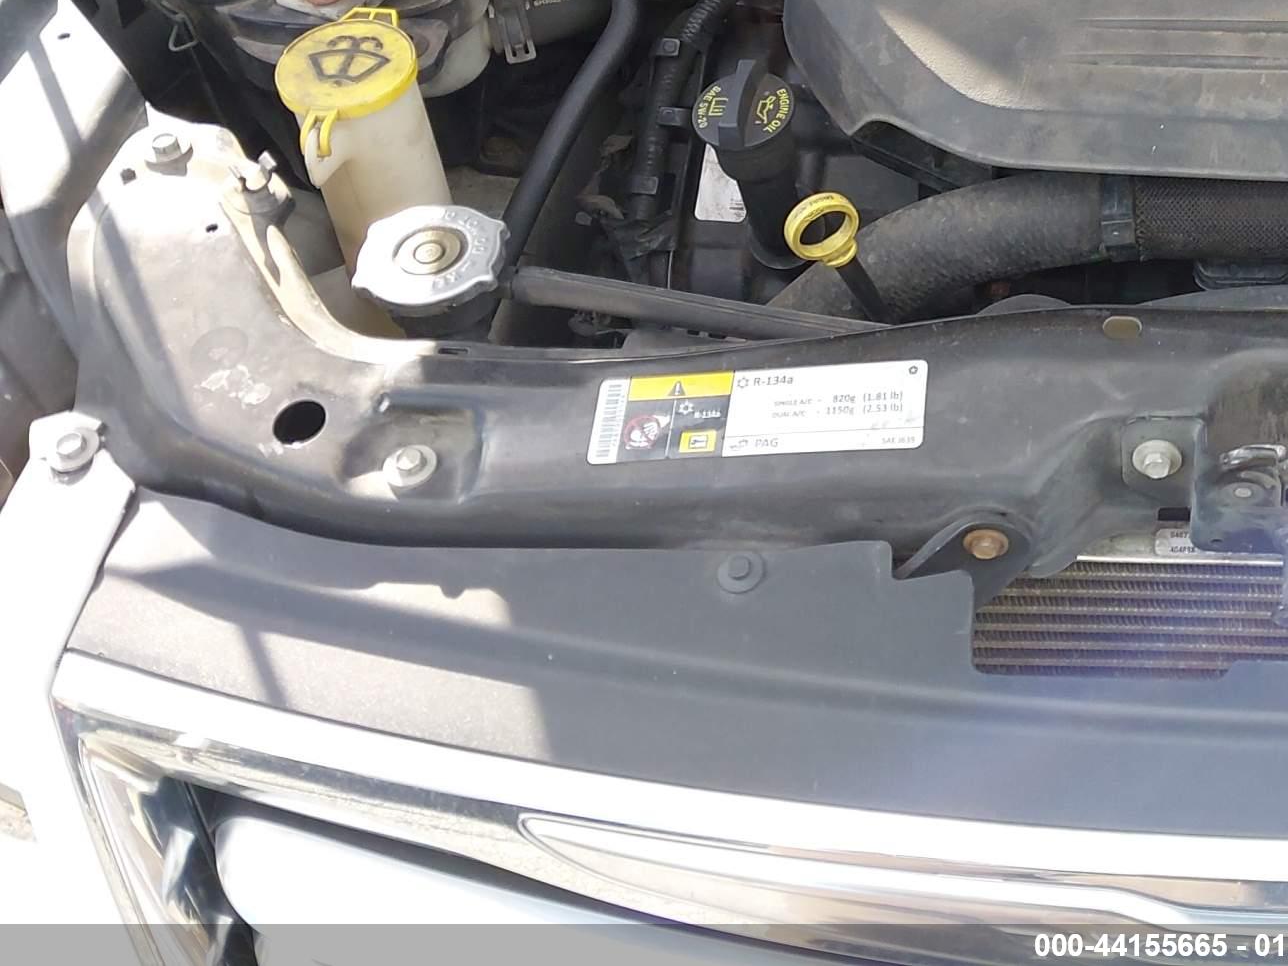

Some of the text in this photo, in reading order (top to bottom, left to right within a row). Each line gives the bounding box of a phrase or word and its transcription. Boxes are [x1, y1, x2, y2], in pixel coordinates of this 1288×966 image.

[763, 88, 790, 133] ENGINE OIL
[753, 375, 794, 387] R-134a
[863, 391, 887, 403] (1.81
[890, 390, 903, 402] lb)
[754, 437, 779, 448] PAG
